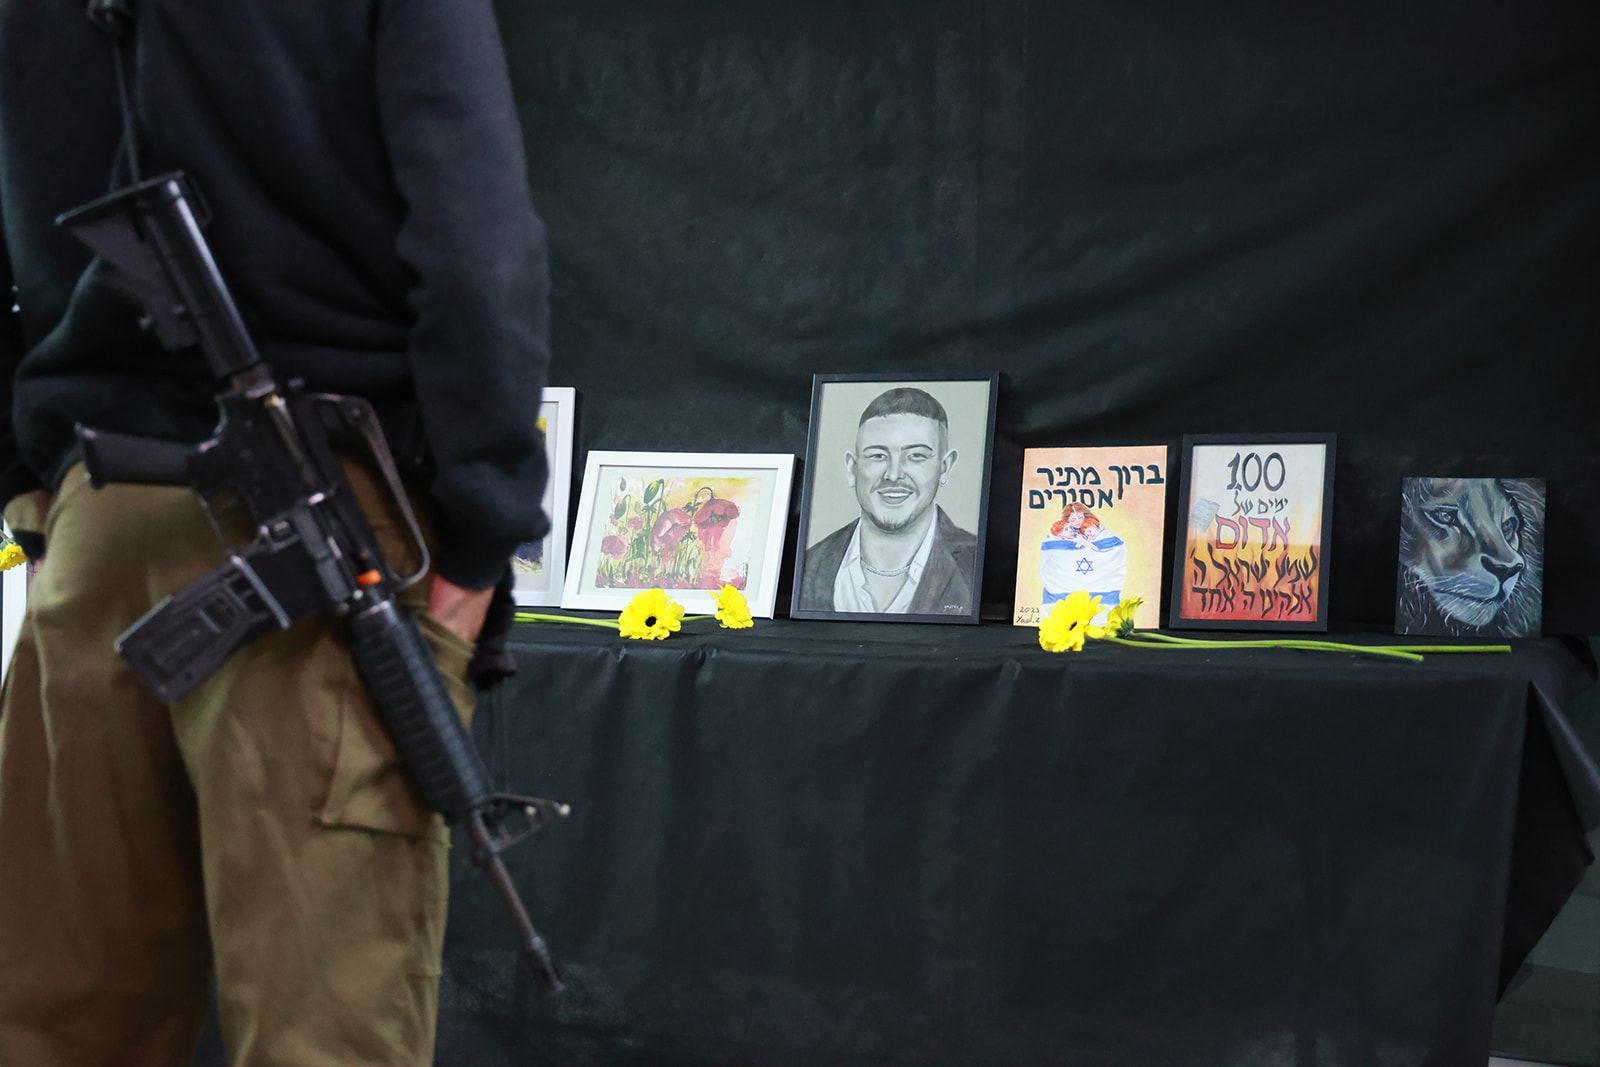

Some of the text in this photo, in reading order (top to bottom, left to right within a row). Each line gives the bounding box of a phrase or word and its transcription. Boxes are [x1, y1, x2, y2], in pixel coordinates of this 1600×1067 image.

[1036, 464, 1165, 500] ברוך מתיר
[1226, 452, 1286, 492] 100
[1029, 488, 1114, 509] אסורים
[1231, 489, 1289, 517] ימים של
[1215, 513, 1291, 551] אדום
[1207, 542, 1270, 588] ישראל
[1273, 545, 1317, 588] שמע
[1192, 586, 1236, 613] אחד
[1260, 584, 1312, 619] אלקינו
